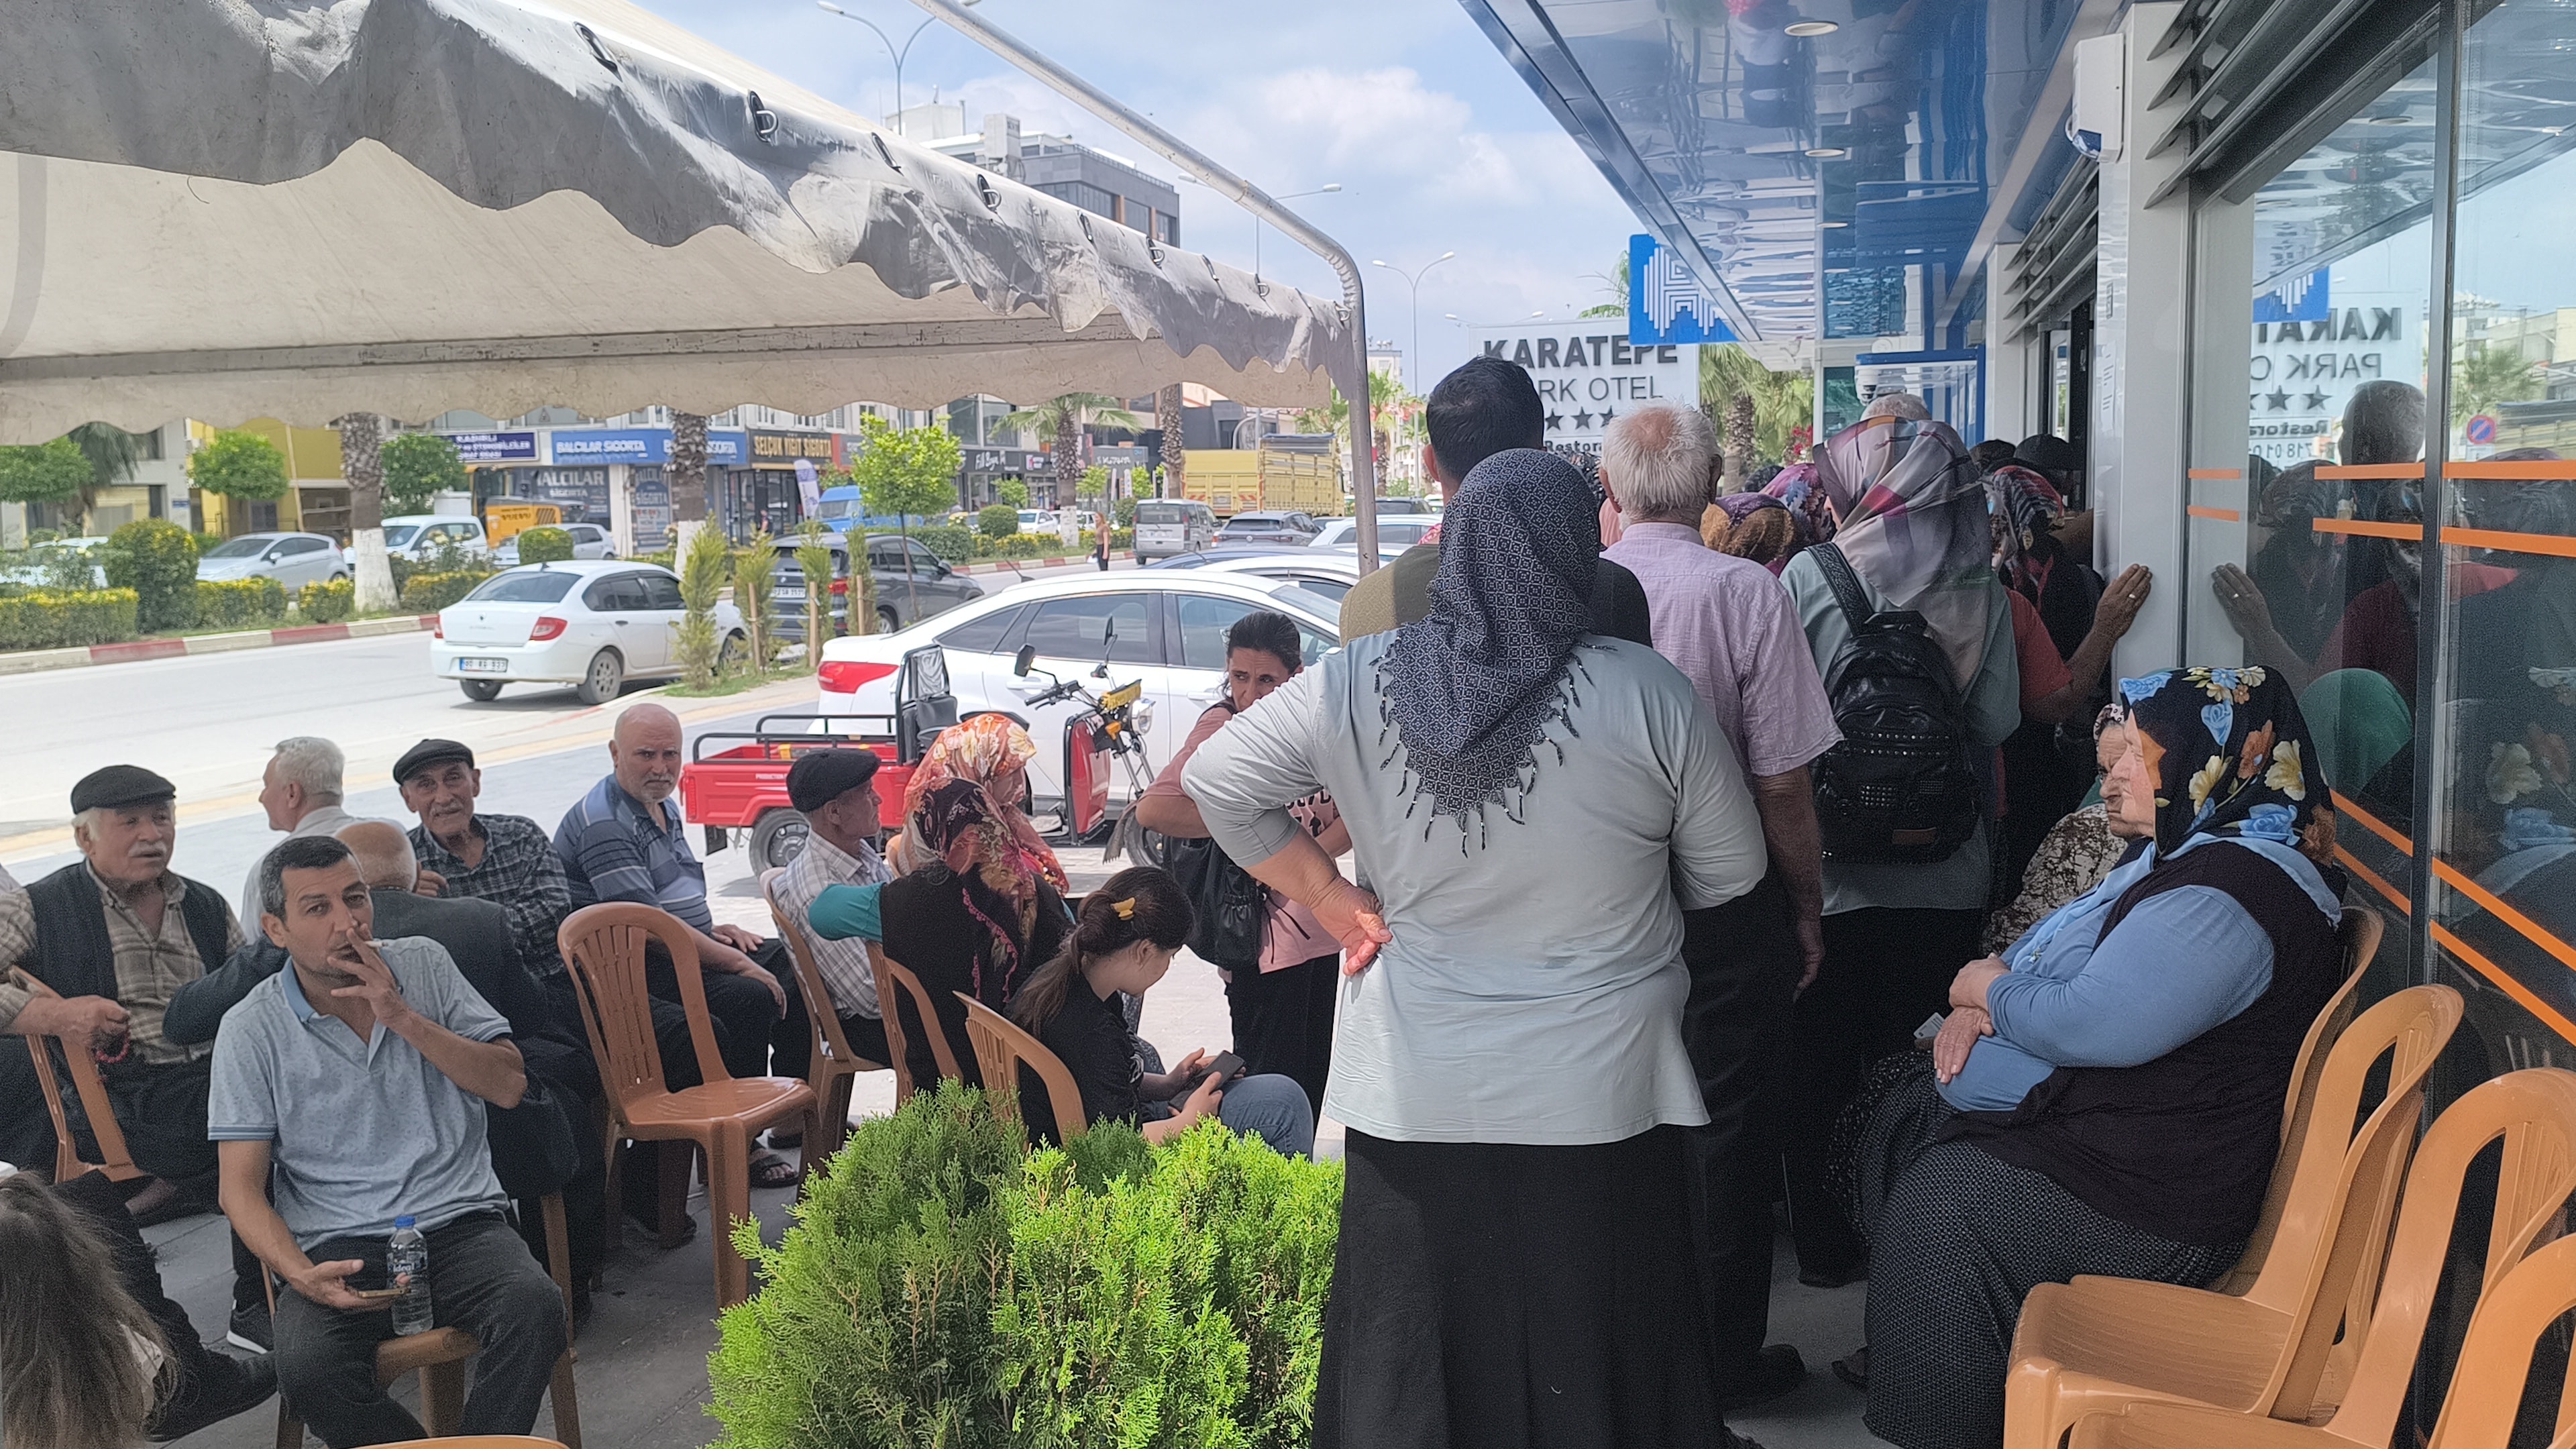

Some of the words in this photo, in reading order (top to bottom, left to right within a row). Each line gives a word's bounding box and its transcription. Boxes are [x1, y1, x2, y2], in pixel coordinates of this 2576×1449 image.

[1483, 334, 1677, 368] KARATEPE
[1538, 378, 1577, 402] RK
[1588, 376, 1663, 401] OTEL
[555, 441, 602, 454] BALCILAR
[537, 470, 604, 486] ALCILAR
